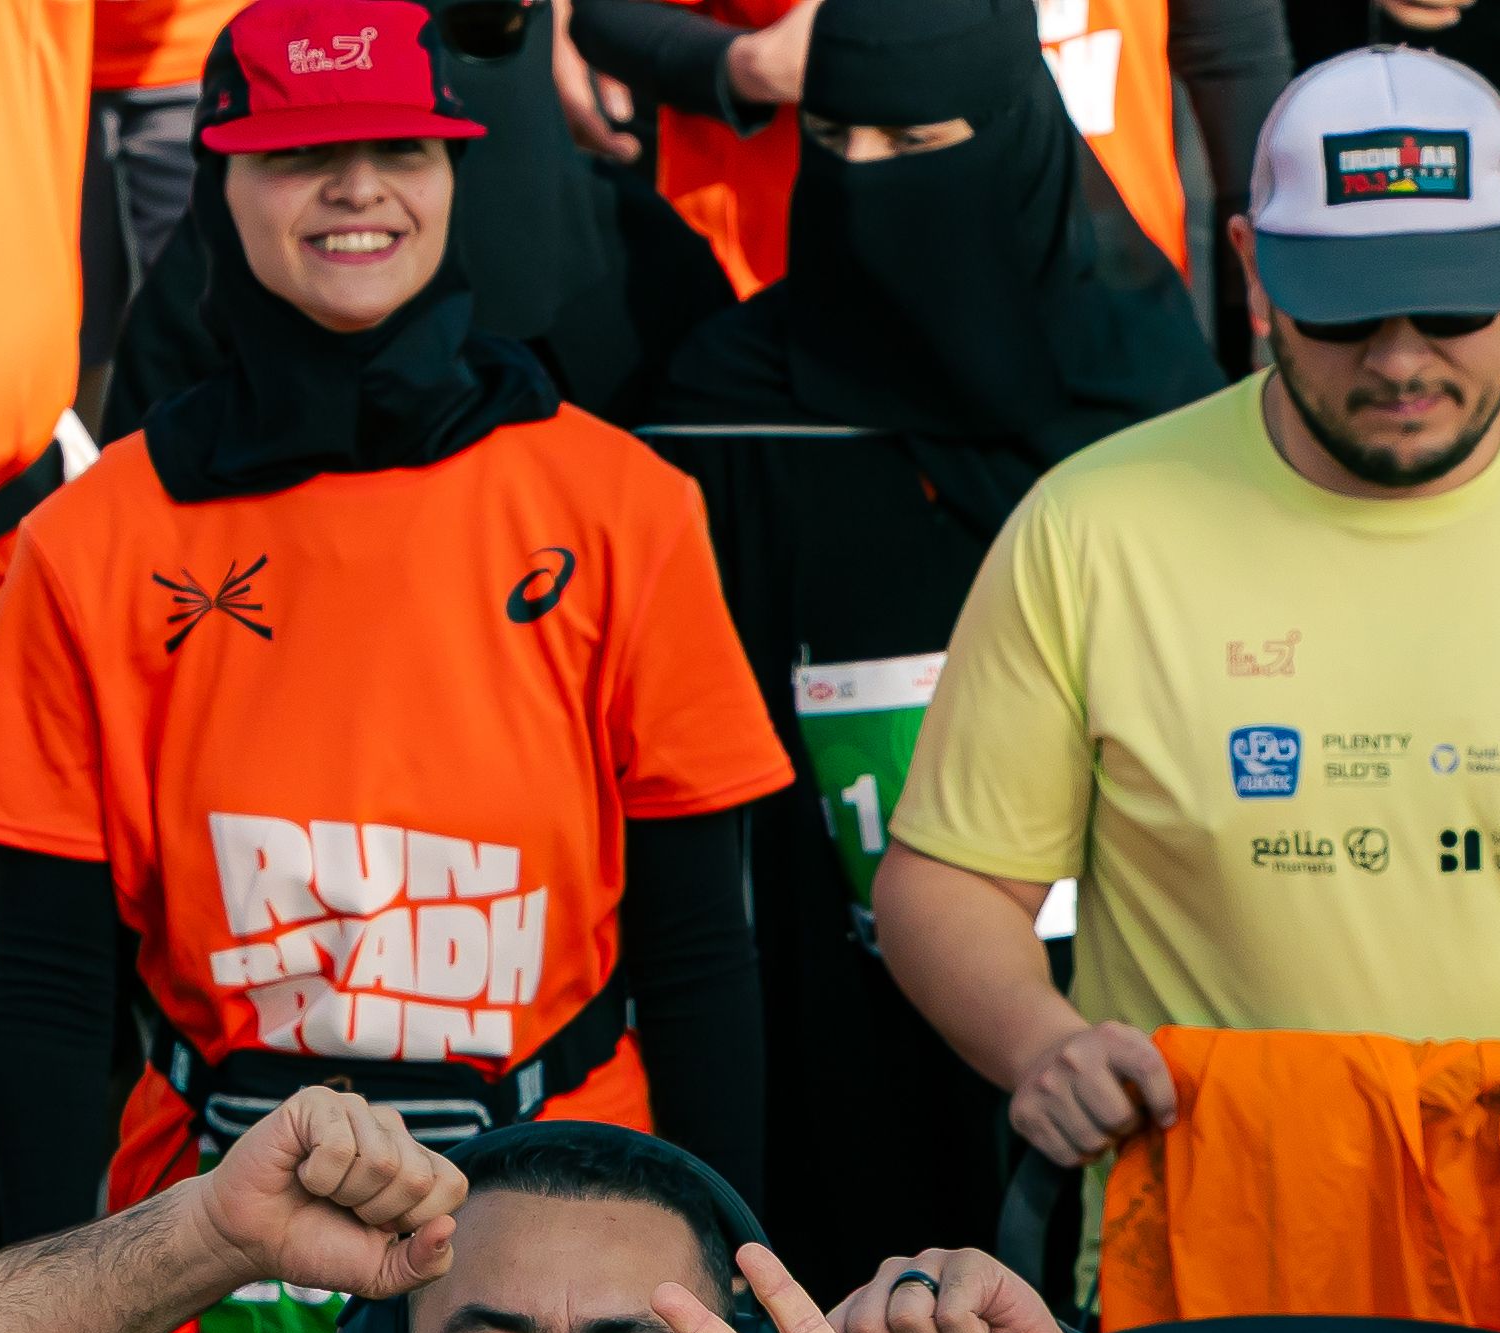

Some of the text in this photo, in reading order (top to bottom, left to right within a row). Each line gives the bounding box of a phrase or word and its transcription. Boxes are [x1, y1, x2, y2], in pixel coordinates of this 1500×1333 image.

[208, 811, 522, 938] RUN
[210, 886, 548, 1005] RIYADH
[244, 974, 514, 1061] RUN
